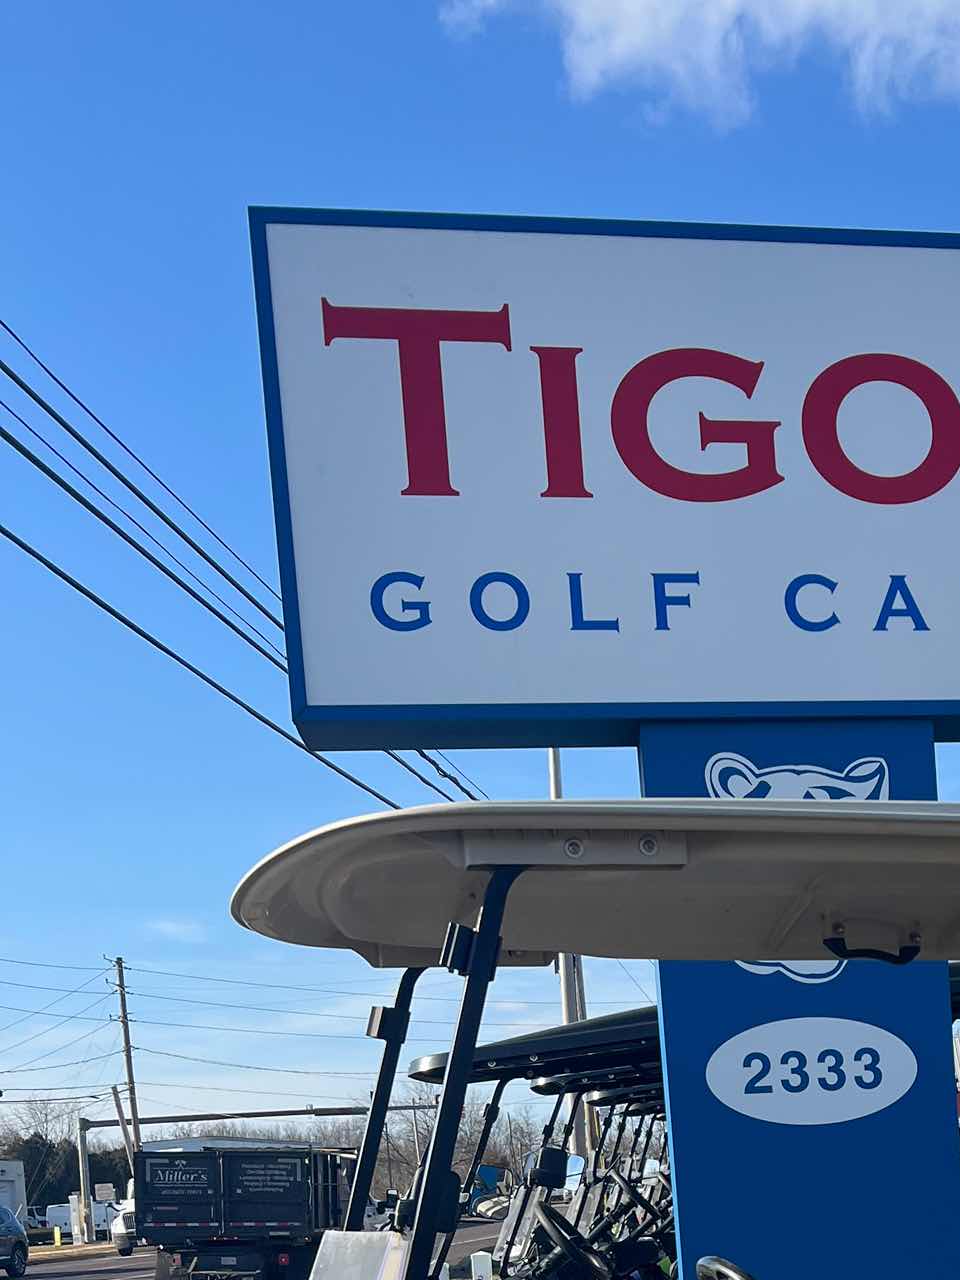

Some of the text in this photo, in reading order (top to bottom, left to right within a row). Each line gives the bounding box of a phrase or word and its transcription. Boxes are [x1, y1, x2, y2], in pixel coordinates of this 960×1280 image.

[370, 571, 701, 633] GOLF
[743, 1047, 883, 1095] 2333
[155, 1169, 208, 1183] Miller's
